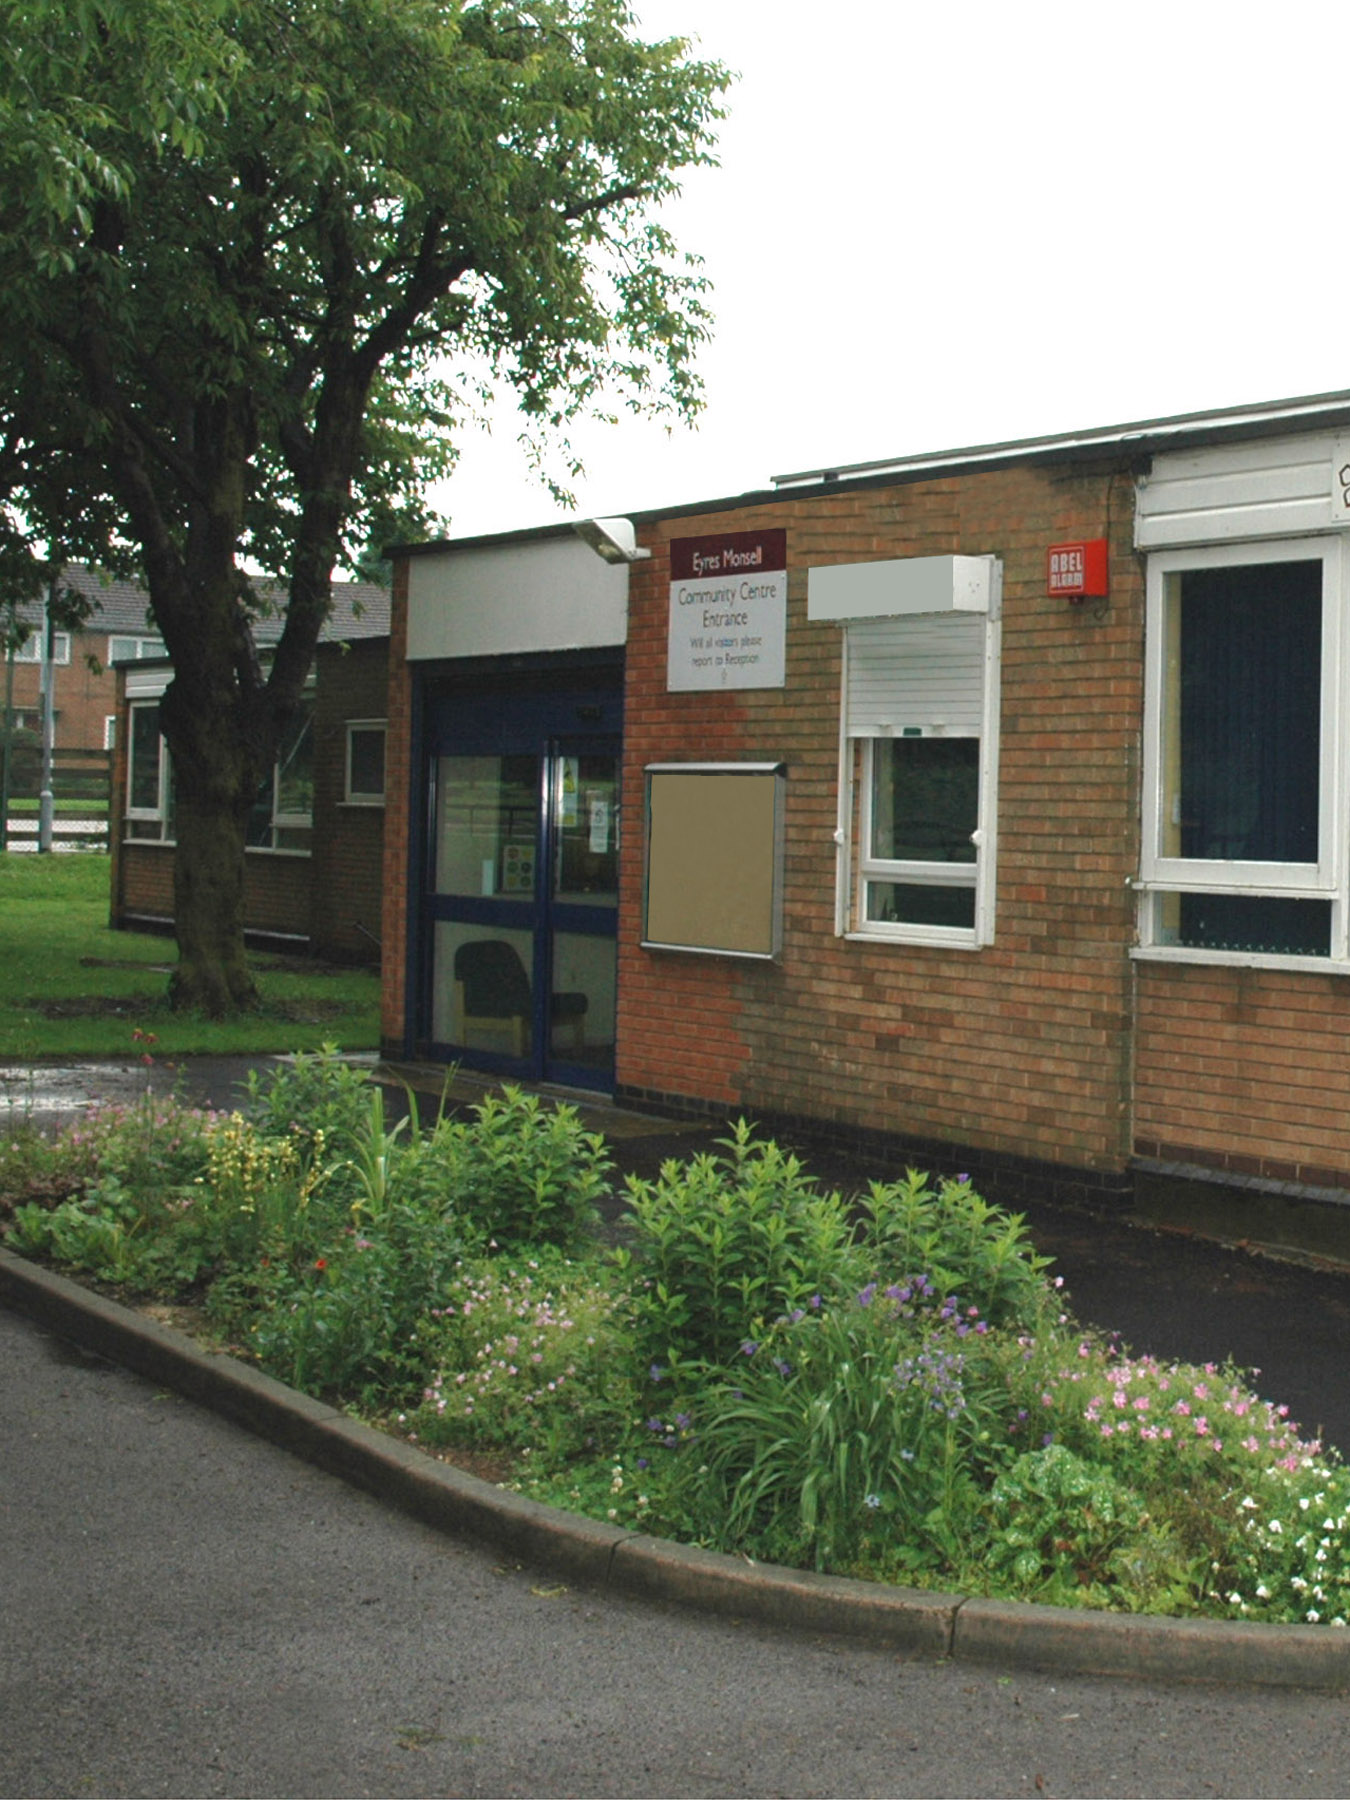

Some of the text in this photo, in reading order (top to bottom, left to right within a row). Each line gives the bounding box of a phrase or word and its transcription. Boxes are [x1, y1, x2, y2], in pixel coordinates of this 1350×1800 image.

[692, 546, 763, 576] Eyres Monsell
[1050, 551, 1083, 573] ABEL
[678, 581, 777, 607] Community Centre
[702, 610, 748, 628] Entrance
